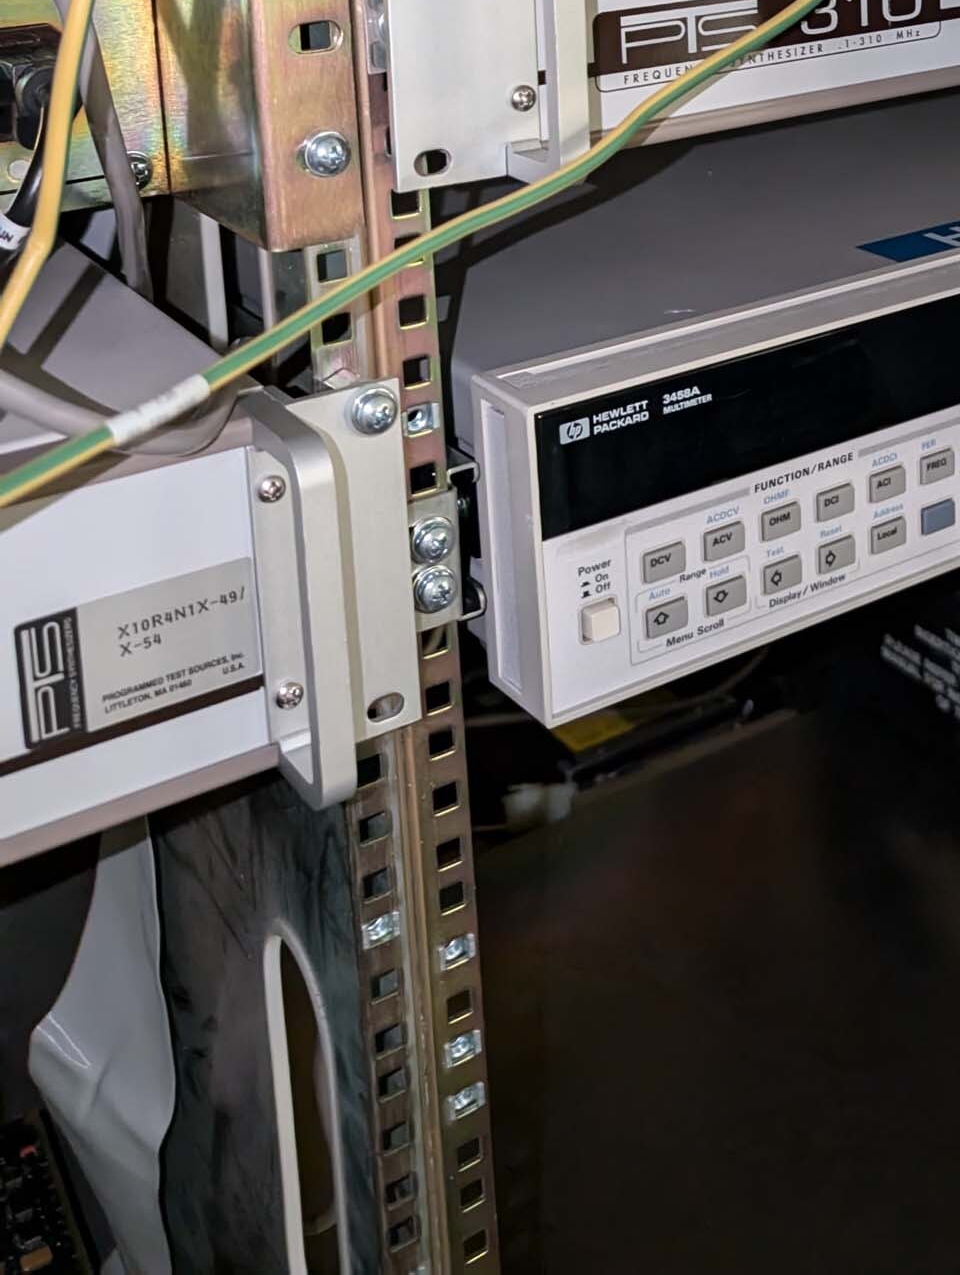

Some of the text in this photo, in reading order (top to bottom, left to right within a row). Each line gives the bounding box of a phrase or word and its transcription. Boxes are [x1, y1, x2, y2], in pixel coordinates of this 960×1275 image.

[623, 64, 695, 86] FREQUEN
[896, 28, 921, 40] MHz
[662, 385, 701, 405] 3458A
[592, 400, 649, 424] HEWLETT
[662, 393, 713, 415] MULTIMETER
[593, 411, 650, 435] PACKARD
[754, 452, 854, 493] FUNCTION/RANGE
[876, 478, 892, 489] ACI
[824, 496, 839, 508] DCI
[706, 504, 741, 524] ACDCV
[769, 512, 791, 526] OHM
[873, 504, 904, 519] Address
[820, 524, 843, 539] Reset
[877, 527, 898, 540] Local
[712, 532, 733, 548] ACV
[766, 545, 785, 558] Test
[578, 559, 612, 576] Power
[650, 553, 672, 568] DCV
[595, 573, 609, 583] On
[679, 568, 707, 584] Range
[709, 564, 730, 580] Hold
[595, 582, 611, 594] Off
[117, 586, 246, 640] X10R4N1X-49/
[666, 618, 725, 648] Menu Scroll
[119, 634, 163, 657] X-54
[102, 676, 164, 702] PROGRAMMED
[166, 668, 187, 683] TEST
[188, 657, 229, 676] SOURCES,
[105, 693, 153, 714] LITTLETON,
[154, 687, 168, 698] MA
